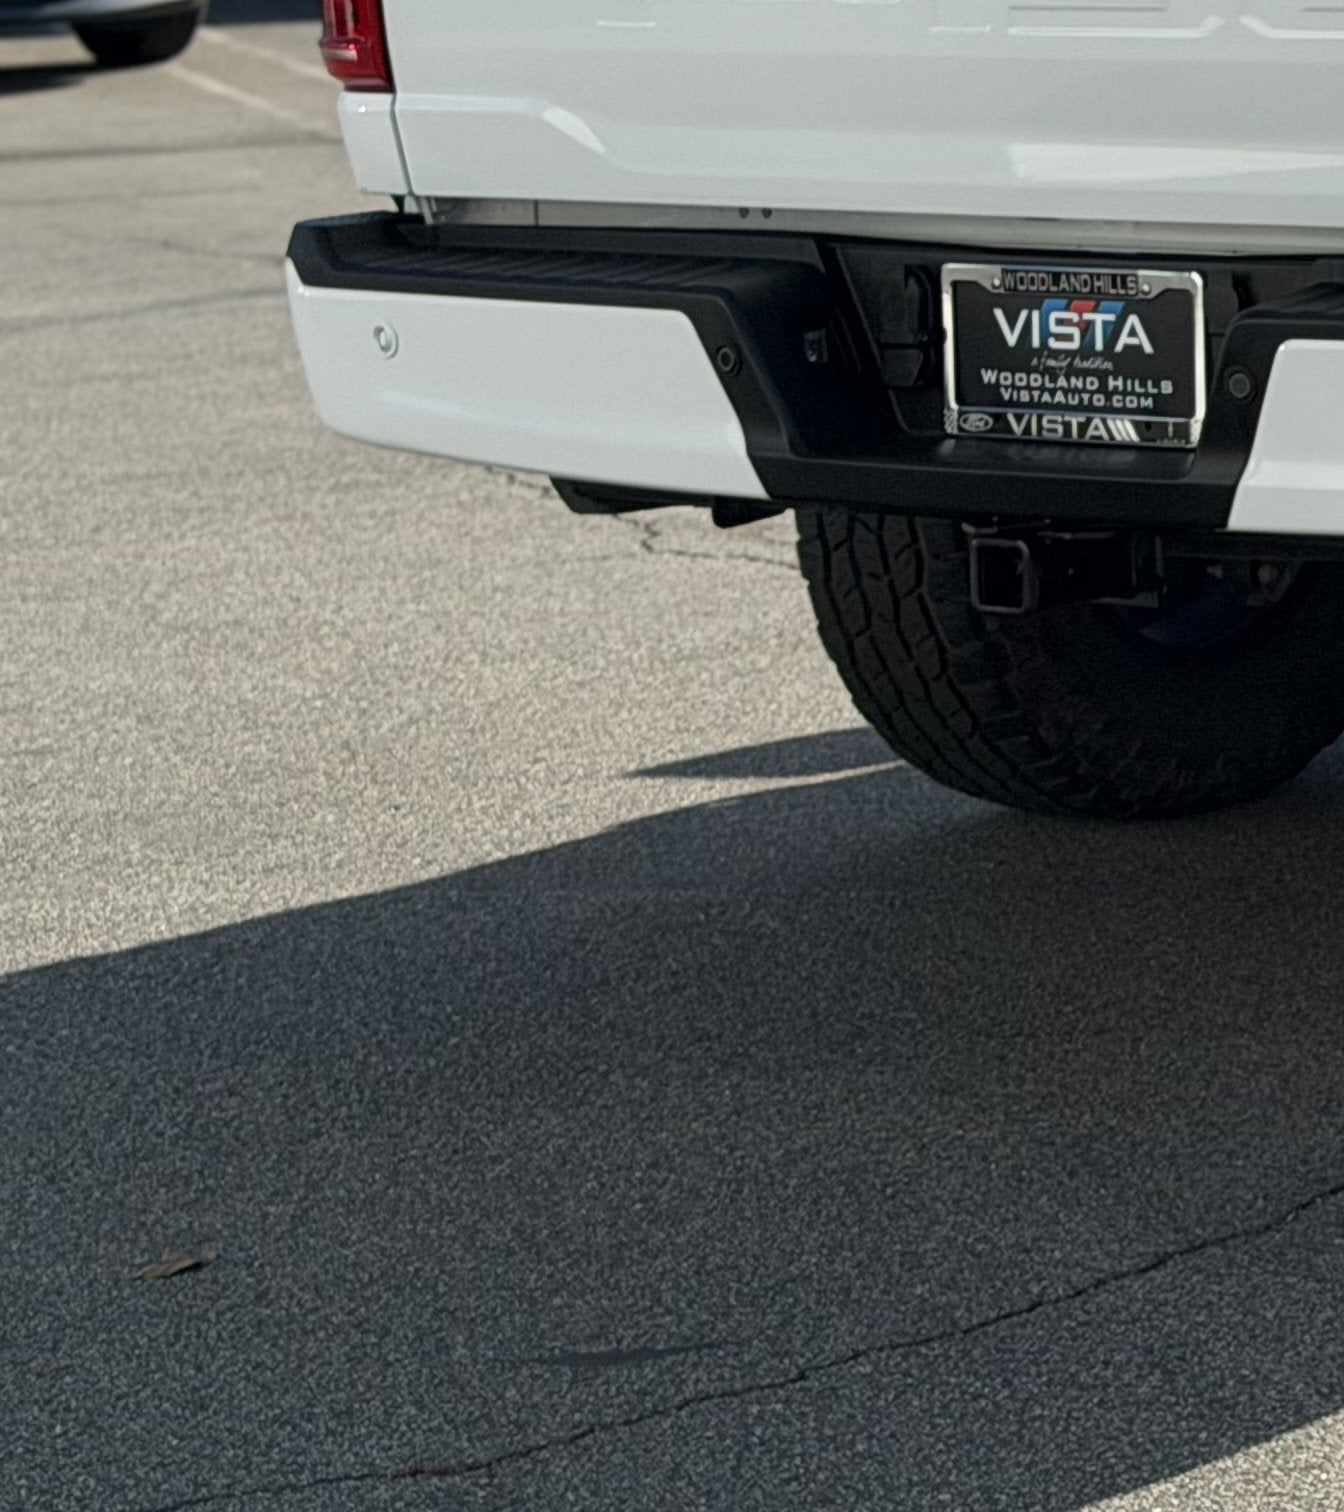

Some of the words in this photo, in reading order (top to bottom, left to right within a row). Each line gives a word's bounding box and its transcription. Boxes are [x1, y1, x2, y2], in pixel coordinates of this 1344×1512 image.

[1003, 271, 1092, 293] WOODLAND
[1093, 276, 1137, 296] HILLS
[993, 307, 1155, 355] VISTA
[1006, 412, 1111, 442] VISTA
